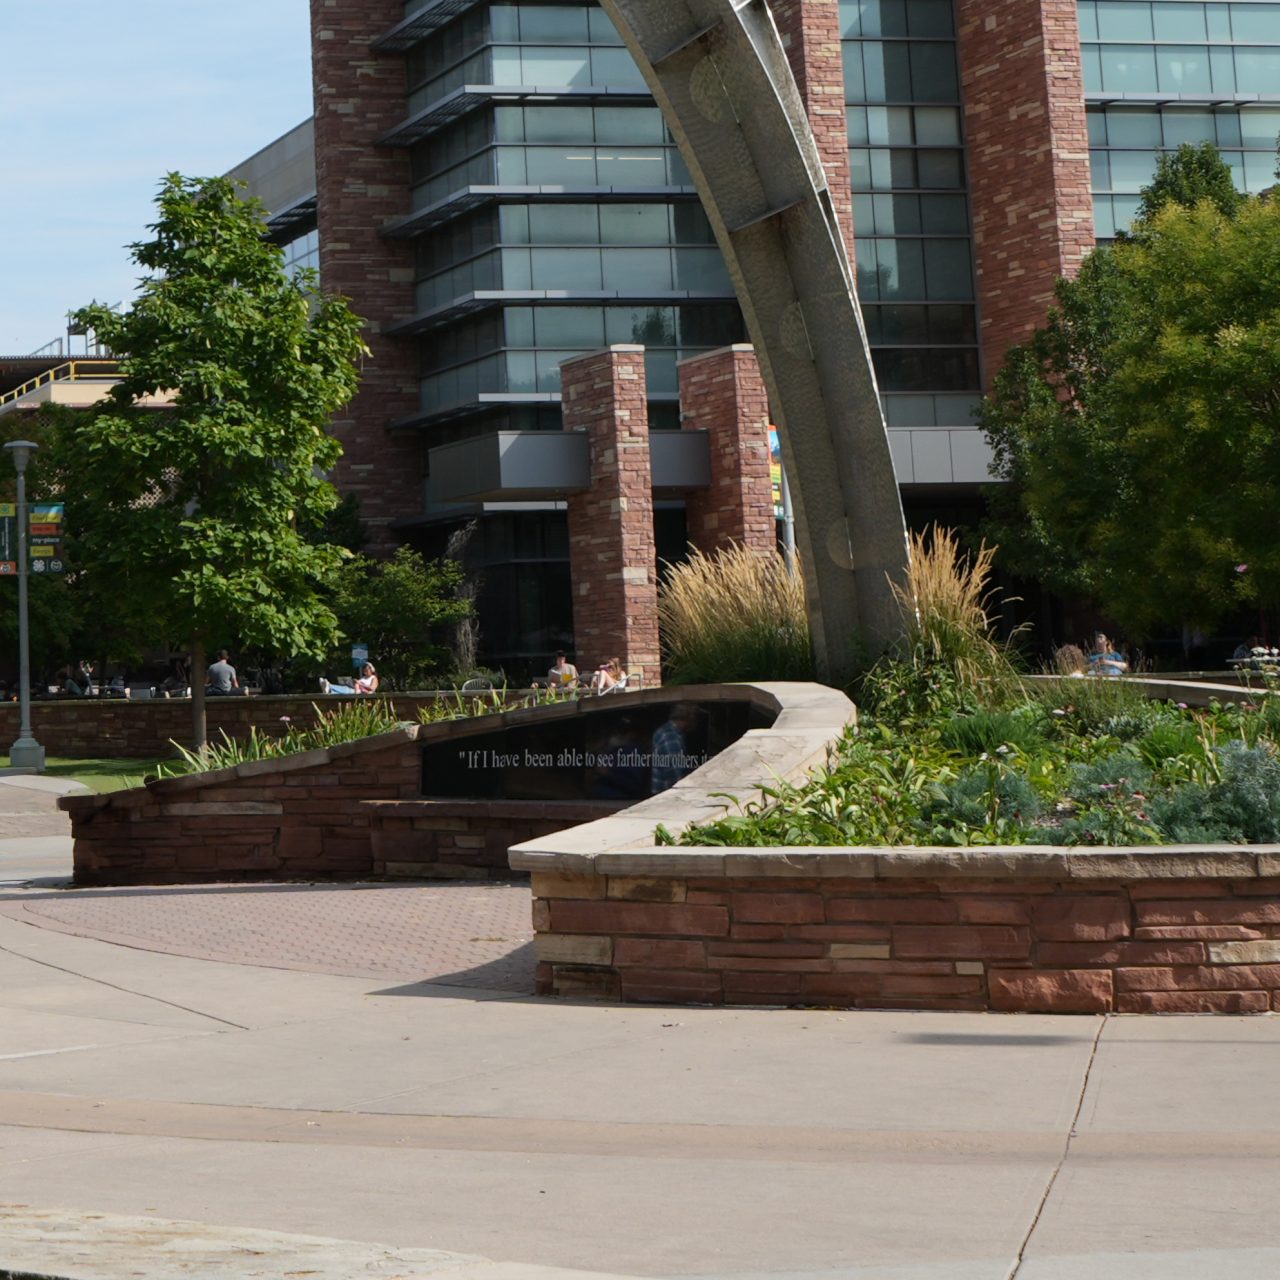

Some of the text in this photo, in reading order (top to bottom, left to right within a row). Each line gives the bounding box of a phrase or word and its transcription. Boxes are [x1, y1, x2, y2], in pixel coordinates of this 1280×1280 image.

[482, 750, 488, 768] I
[491, 750, 520, 768] have
[524, 748, 553, 767] been
[557, 748, 583, 767] able
[585, 751, 595, 767] to
[597, 753, 614, 767] see
[616, 748, 651, 768] farther
[652, 750, 670, 767] than
